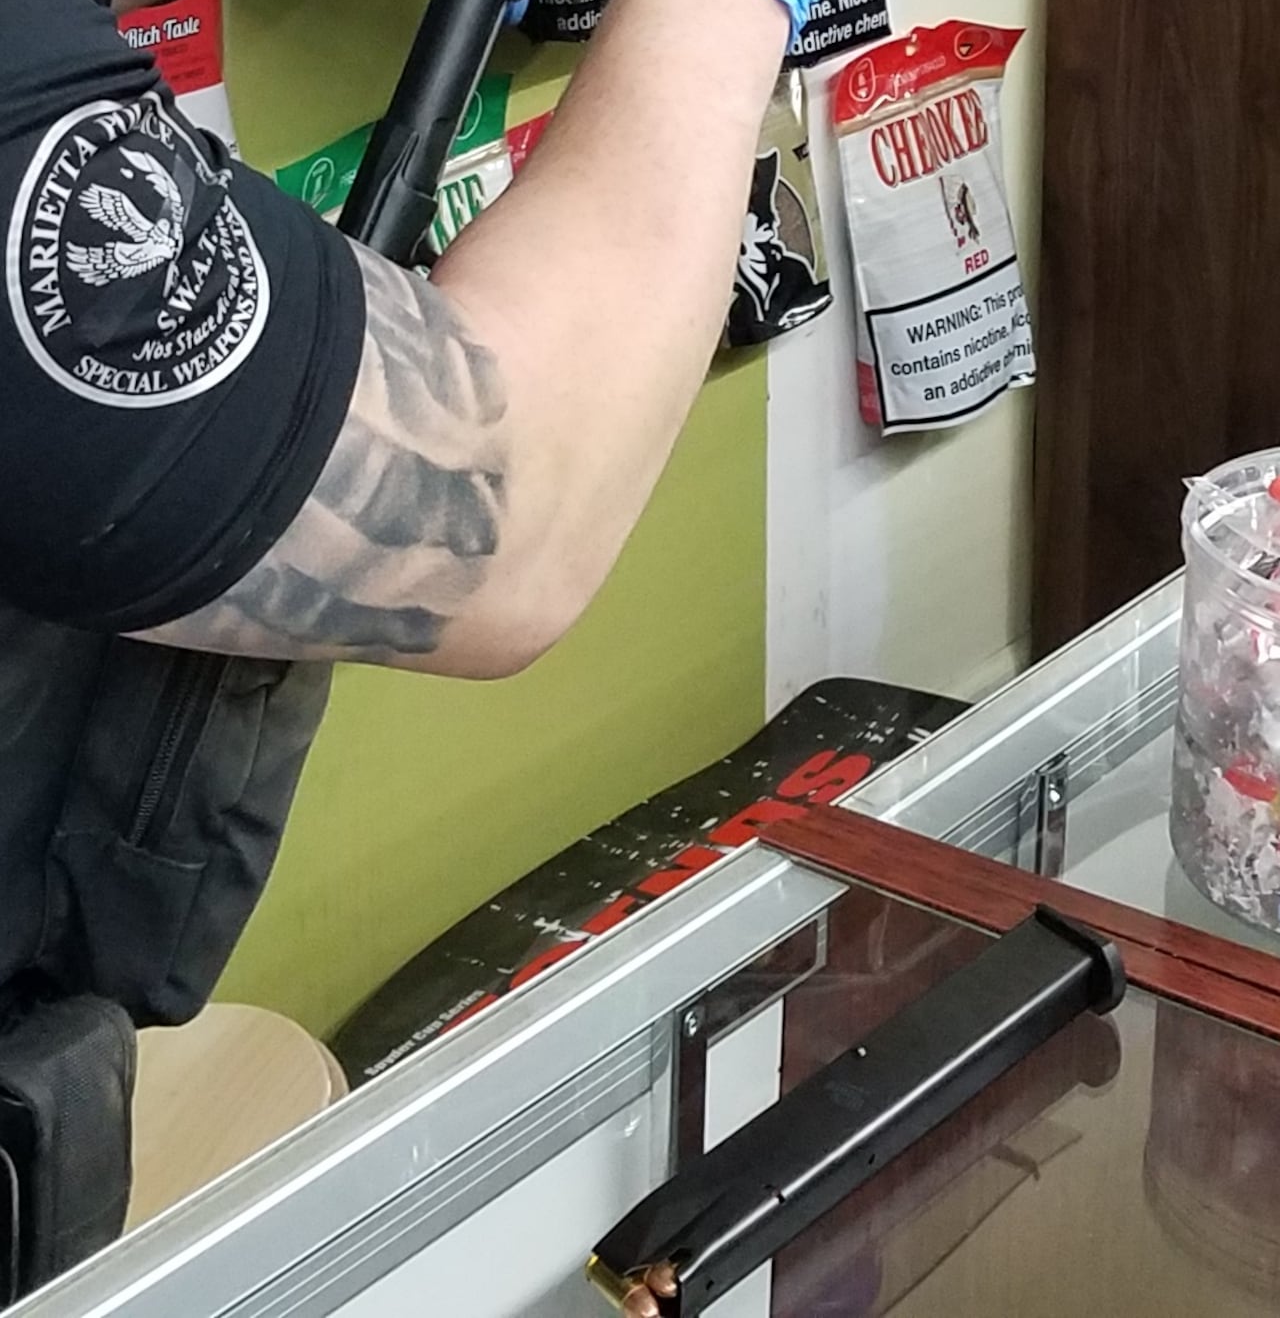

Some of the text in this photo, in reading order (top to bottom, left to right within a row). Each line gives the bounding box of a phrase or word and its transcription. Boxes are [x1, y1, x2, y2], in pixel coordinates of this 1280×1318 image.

[118, 16, 201, 49] Rich Taste
[29, 135, 98, 337] MARIETTA
[156, 227, 220, 337] S.W.A.T.
[964, 249, 990, 275] RED
[73, 355, 168, 394] SPECIAL
[172, 293, 256, 385] WEAPONS
[237, 246, 258, 299] AND
[906, 303, 983, 345] WARNING:
[983, 294, 1007, 315] This
[891, 347, 961, 376] contains
[963, 325, 1010, 359] nicotine.
[924, 384, 946, 402] an
[949, 357, 1002, 396] addictive
[438, 988, 487, 1023] Series
